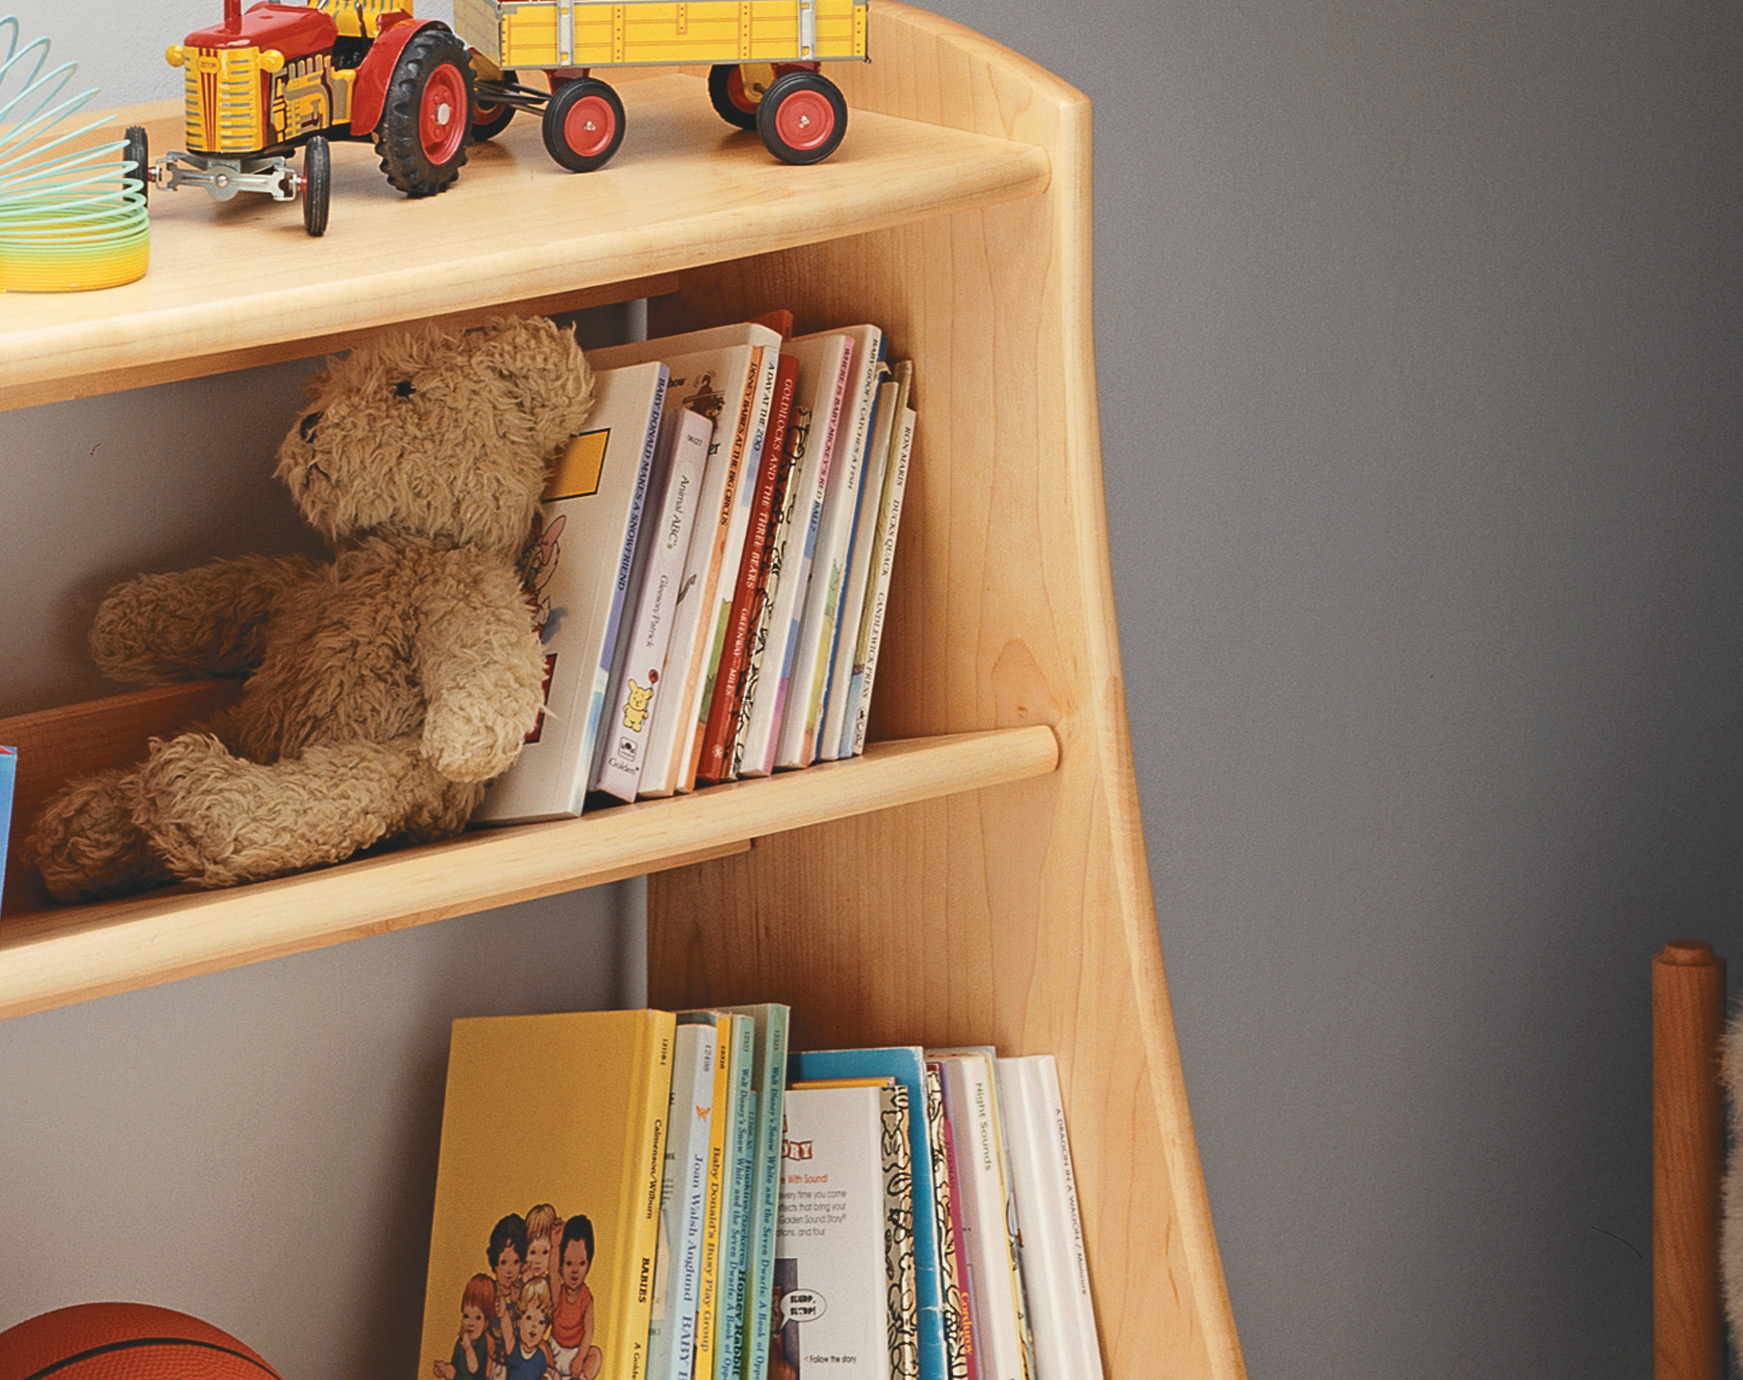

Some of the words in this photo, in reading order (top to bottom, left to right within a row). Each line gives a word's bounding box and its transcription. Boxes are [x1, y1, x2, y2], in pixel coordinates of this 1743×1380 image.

[651, 376, 666, 410] BABY
[642, 410, 659, 457] DONALD
[771, 378, 793, 450] GOLDILOCKS
[634, 459, 650, 500] MAKES
[765, 454, 779, 480] AND
[895, 452, 907, 486] MARIS
[673, 474, 690, 513] Animal
[760, 484, 773, 506] THE
[665, 513, 682, 550] ABC's
[752, 511, 768, 549] THREE
[887, 499, 899, 536] DUCKS
[617, 513, 639, 591] SNOWFRIEND
[744, 550, 760, 589] BEARS
[880, 538, 893, 577] QUACK
[608, 757, 636, 775] Golden
[971, 1081, 988, 1117] Night
[974, 1121, 997, 1171] Sounds
[692, 1154, 704, 1187] Joan
[1055, 1118, 1069, 1166] DRAGON
[1067, 1195, 1080, 1240] WAGON
[688, 1193, 701, 1235] Walsh
[636, 1256, 652, 1302] BABIES
[681, 1241, 697, 1301] Anglund
[734, 1269, 746, 1320] Honey
[678, 1315, 693, 1363] BABY
[956, 1291, 977, 1356] Corduroy
[731, 1323, 743, 1376] Rabbit
